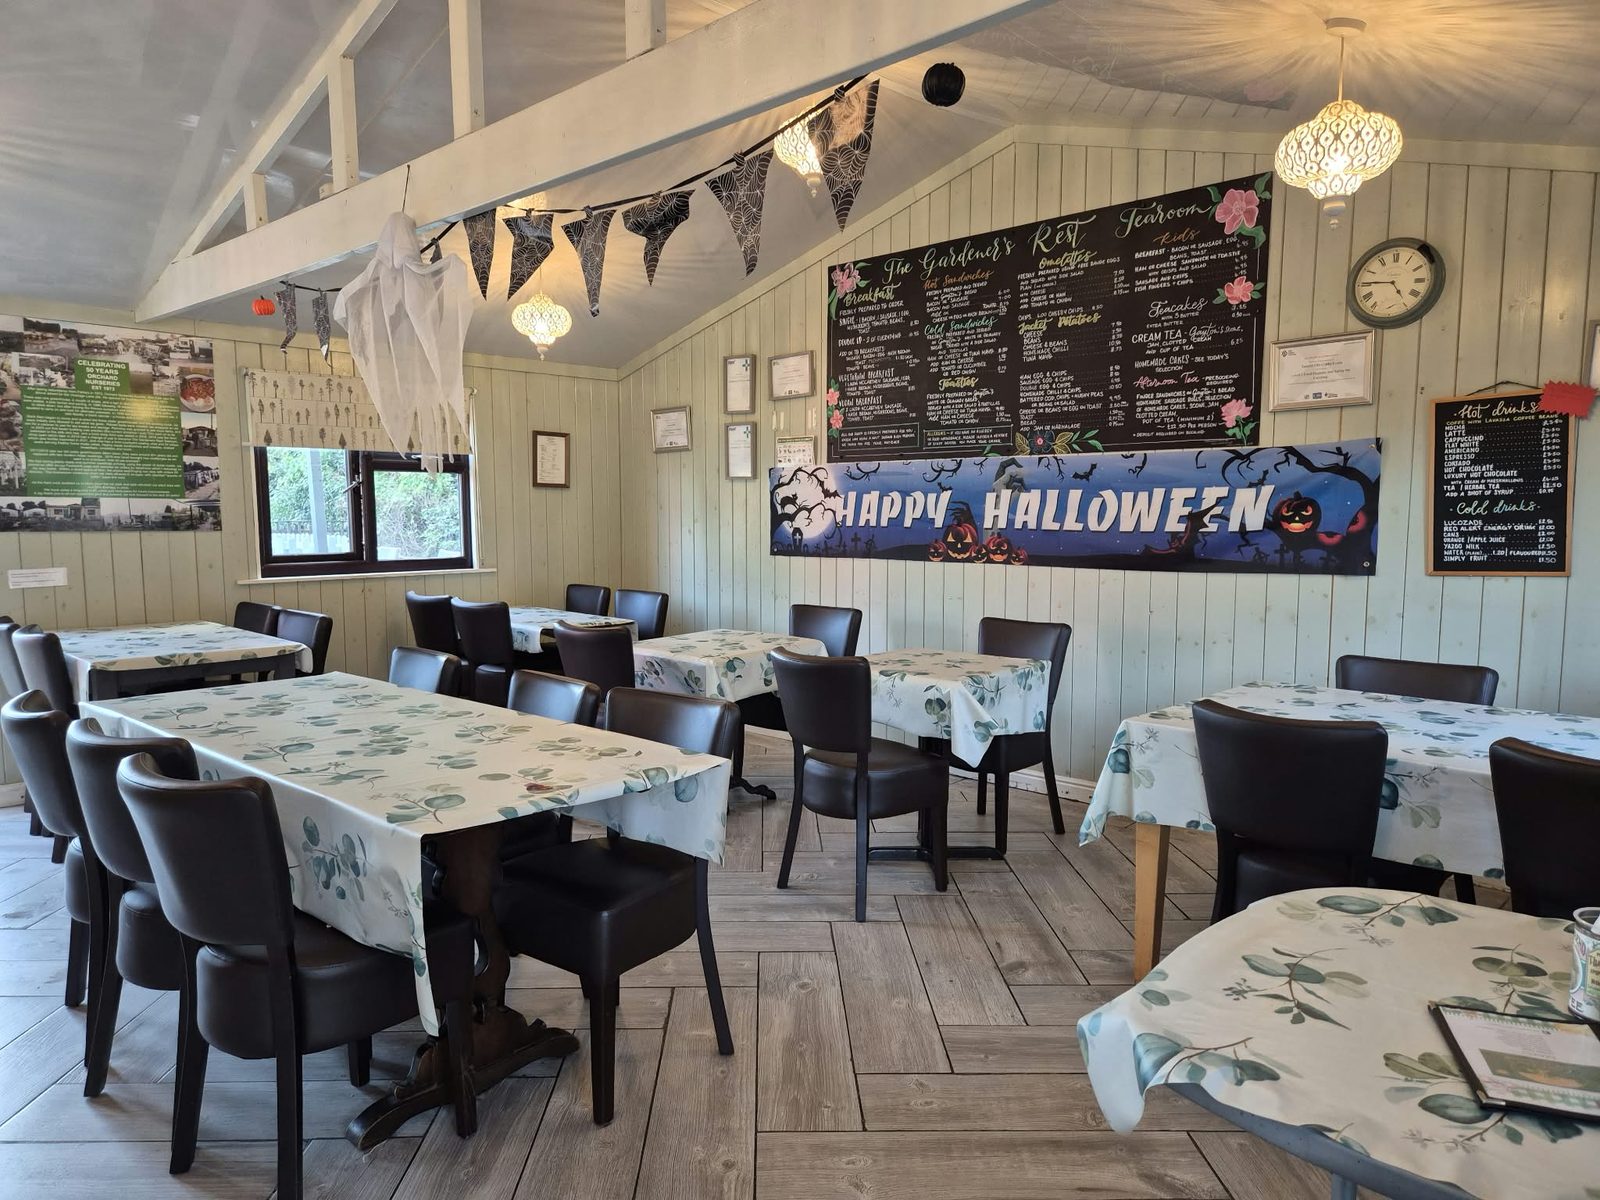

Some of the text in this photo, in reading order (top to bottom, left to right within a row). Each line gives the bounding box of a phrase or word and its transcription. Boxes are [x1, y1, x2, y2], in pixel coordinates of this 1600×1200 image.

[882, 202, 1212, 284] The Gardener's Rest Tearoom
[1153, 228, 1200, 245] Kids
[1156, 261, 1177, 269] CHEESE
[923, 269, 994, 290] Hot Sandwiches
[844, 282, 901, 307] Breakfast
[1149, 296, 1208, 318] Teacakes
[925, 316, 998, 336] Cold Sandwiches
[1018, 318, 1053, 335] Jacket
[1049, 339, 1067, 347] BEANS
[1132, 332, 1161, 344] CREAM
[1164, 330, 1182, 340] TEA
[78, 360, 126, 369] CELEBRATING
[1135, 358, 1167, 368] HOMEMADE
[1170, 355, 1190, 364] CAKES
[939, 376, 979, 391] Toasties
[1133, 371, 1200, 389] Afternoon Tea
[1458, 401, 1538, 418] Hot drinks
[1459, 464, 1494, 472] CHOCOLATE
[834, 485, 1276, 532] HAPPY HALLOWEEN
[1457, 500, 1536, 515] Cold drinks
